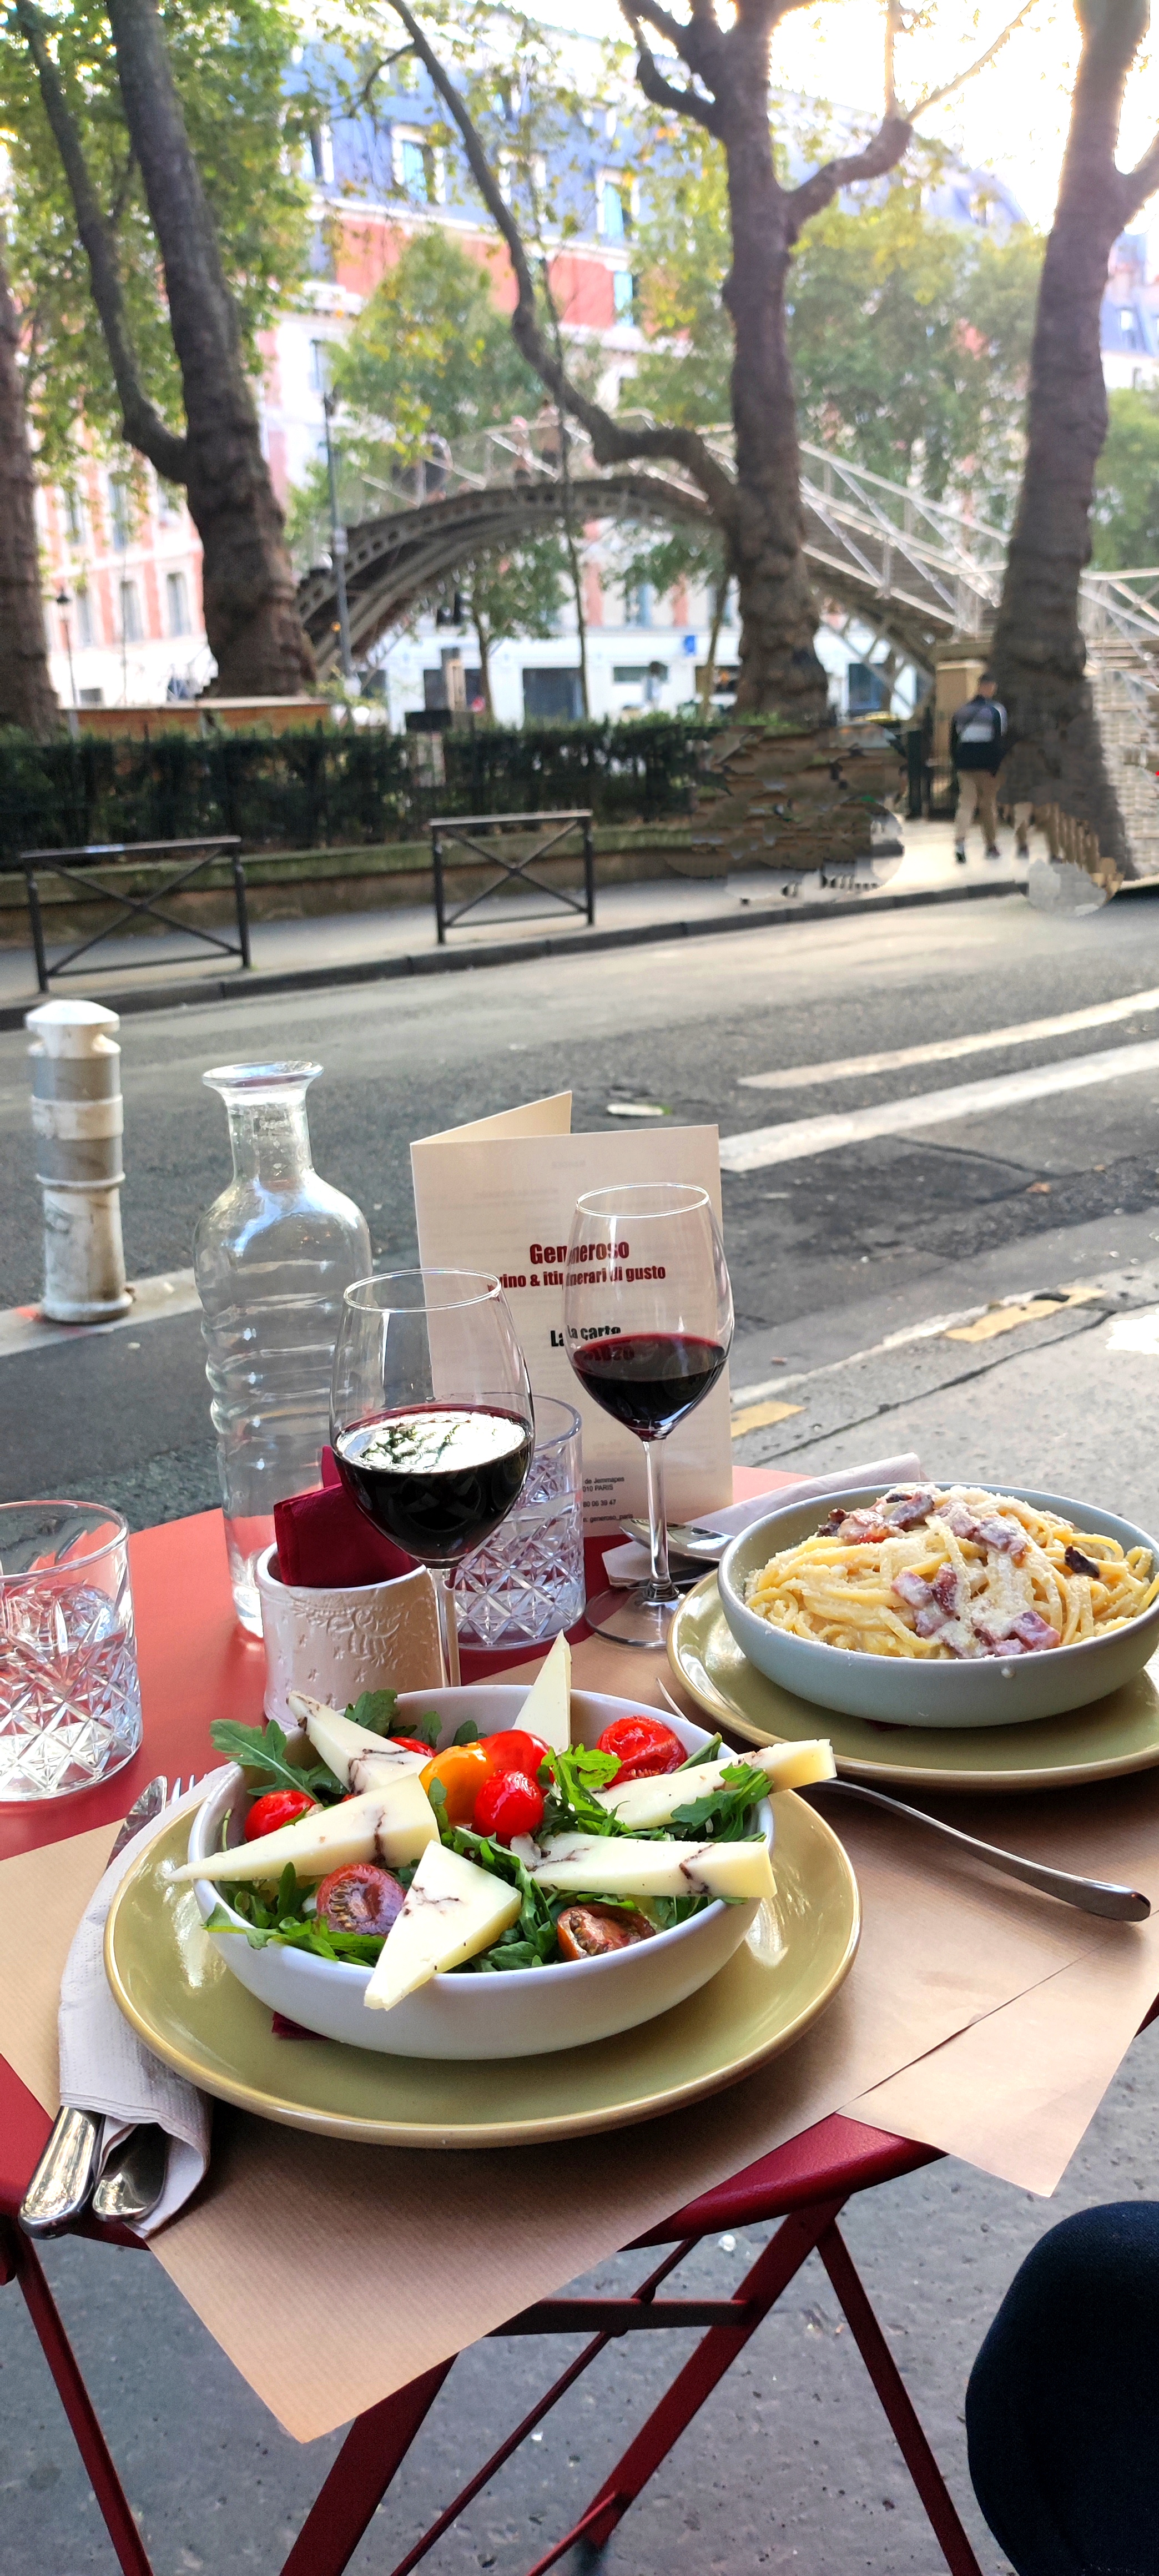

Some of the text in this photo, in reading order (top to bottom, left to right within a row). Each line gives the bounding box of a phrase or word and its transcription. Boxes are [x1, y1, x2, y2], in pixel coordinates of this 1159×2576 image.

[530, 1274, 540, 1286] &
[626, 1265, 666, 1282] gusto
[580, 1325, 621, 1340] carte
